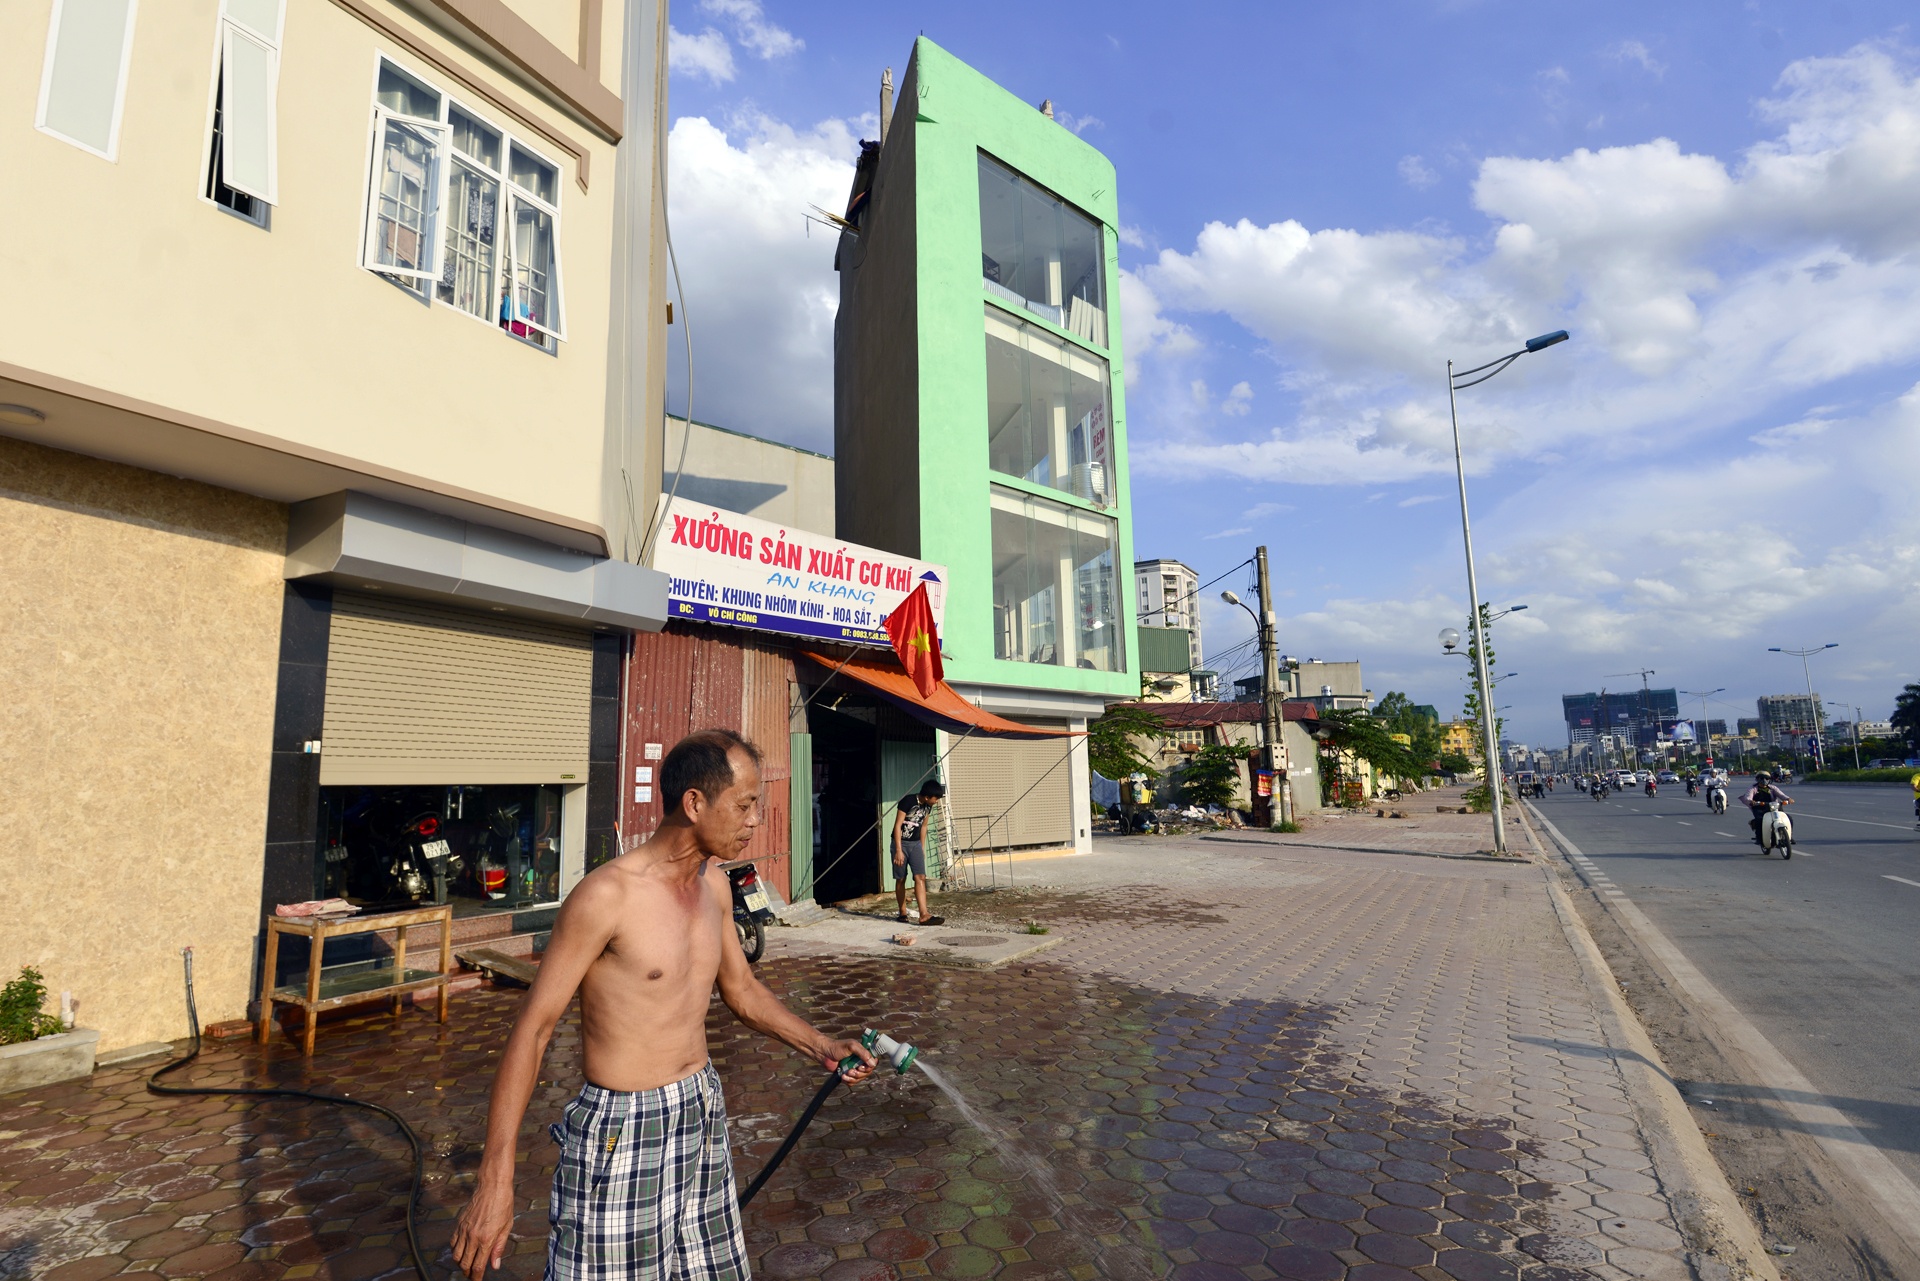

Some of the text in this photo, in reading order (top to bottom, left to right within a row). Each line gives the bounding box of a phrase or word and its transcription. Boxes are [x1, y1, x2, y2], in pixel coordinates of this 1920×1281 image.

[671, 511, 913, 593] XƯỞNG SẢN XUẤT CƠ KHÍ
[721, 586, 762, 609] KHUNG
[764, 594, 797, 615] NHÔM
[799, 598, 824, 619] KÍNH
[832, 606, 852, 624] HOA
[854, 606, 872, 626] SẮT
[766, 572, 876, 605] AN KHANG
[679, 603, 694, 615] ĐC:
[720, 609, 735, 619] CHÍ
[736, 611, 758, 624] CÔNG
